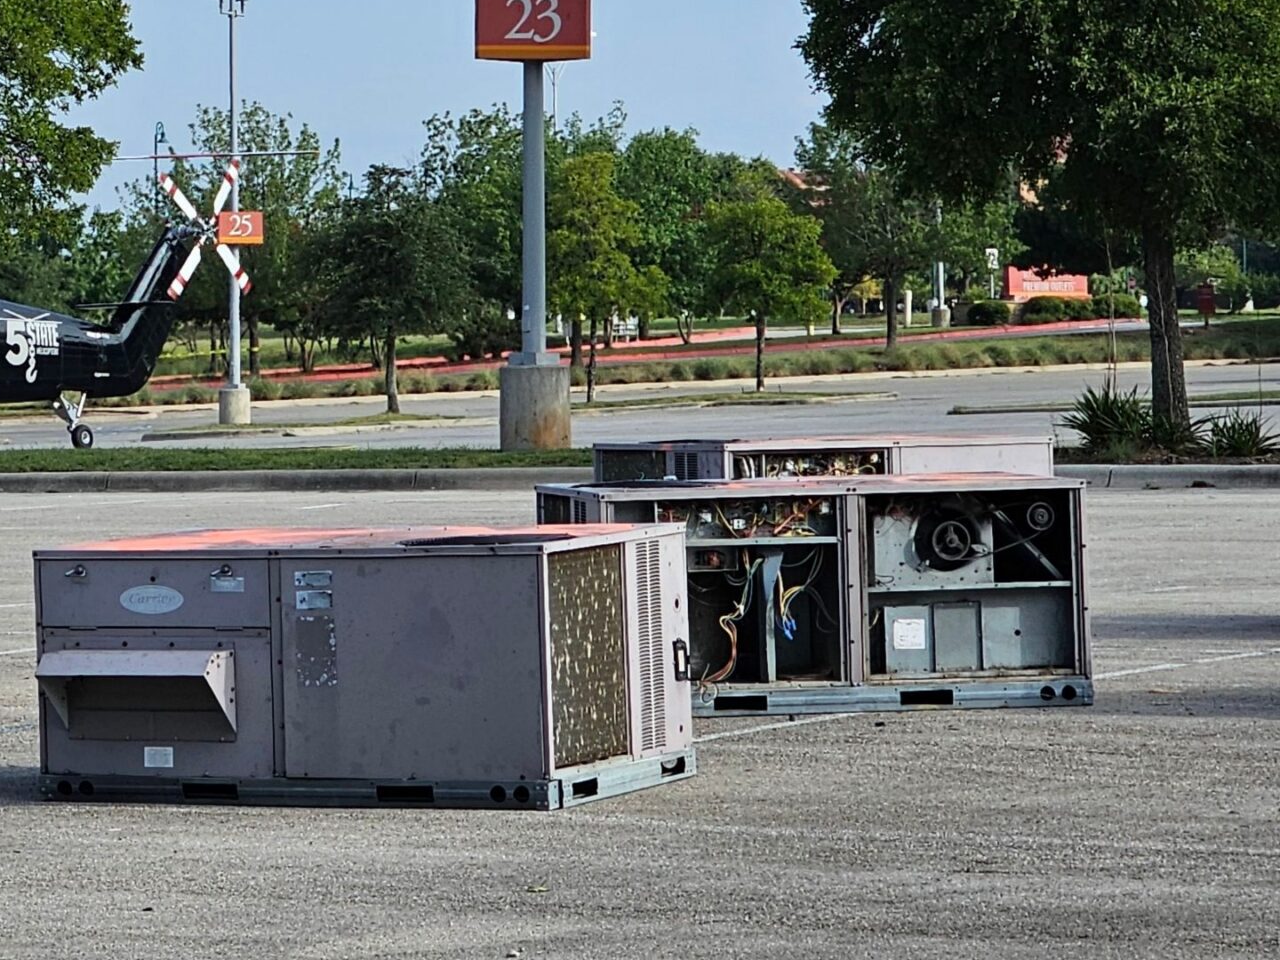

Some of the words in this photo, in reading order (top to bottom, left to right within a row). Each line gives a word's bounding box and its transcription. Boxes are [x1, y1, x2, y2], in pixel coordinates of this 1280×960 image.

[229, 214, 253, 237] 25
[5, 320, 29, 366] 5
[26, 321, 60, 347] STATE
[128, 593, 177, 606] Carrier
